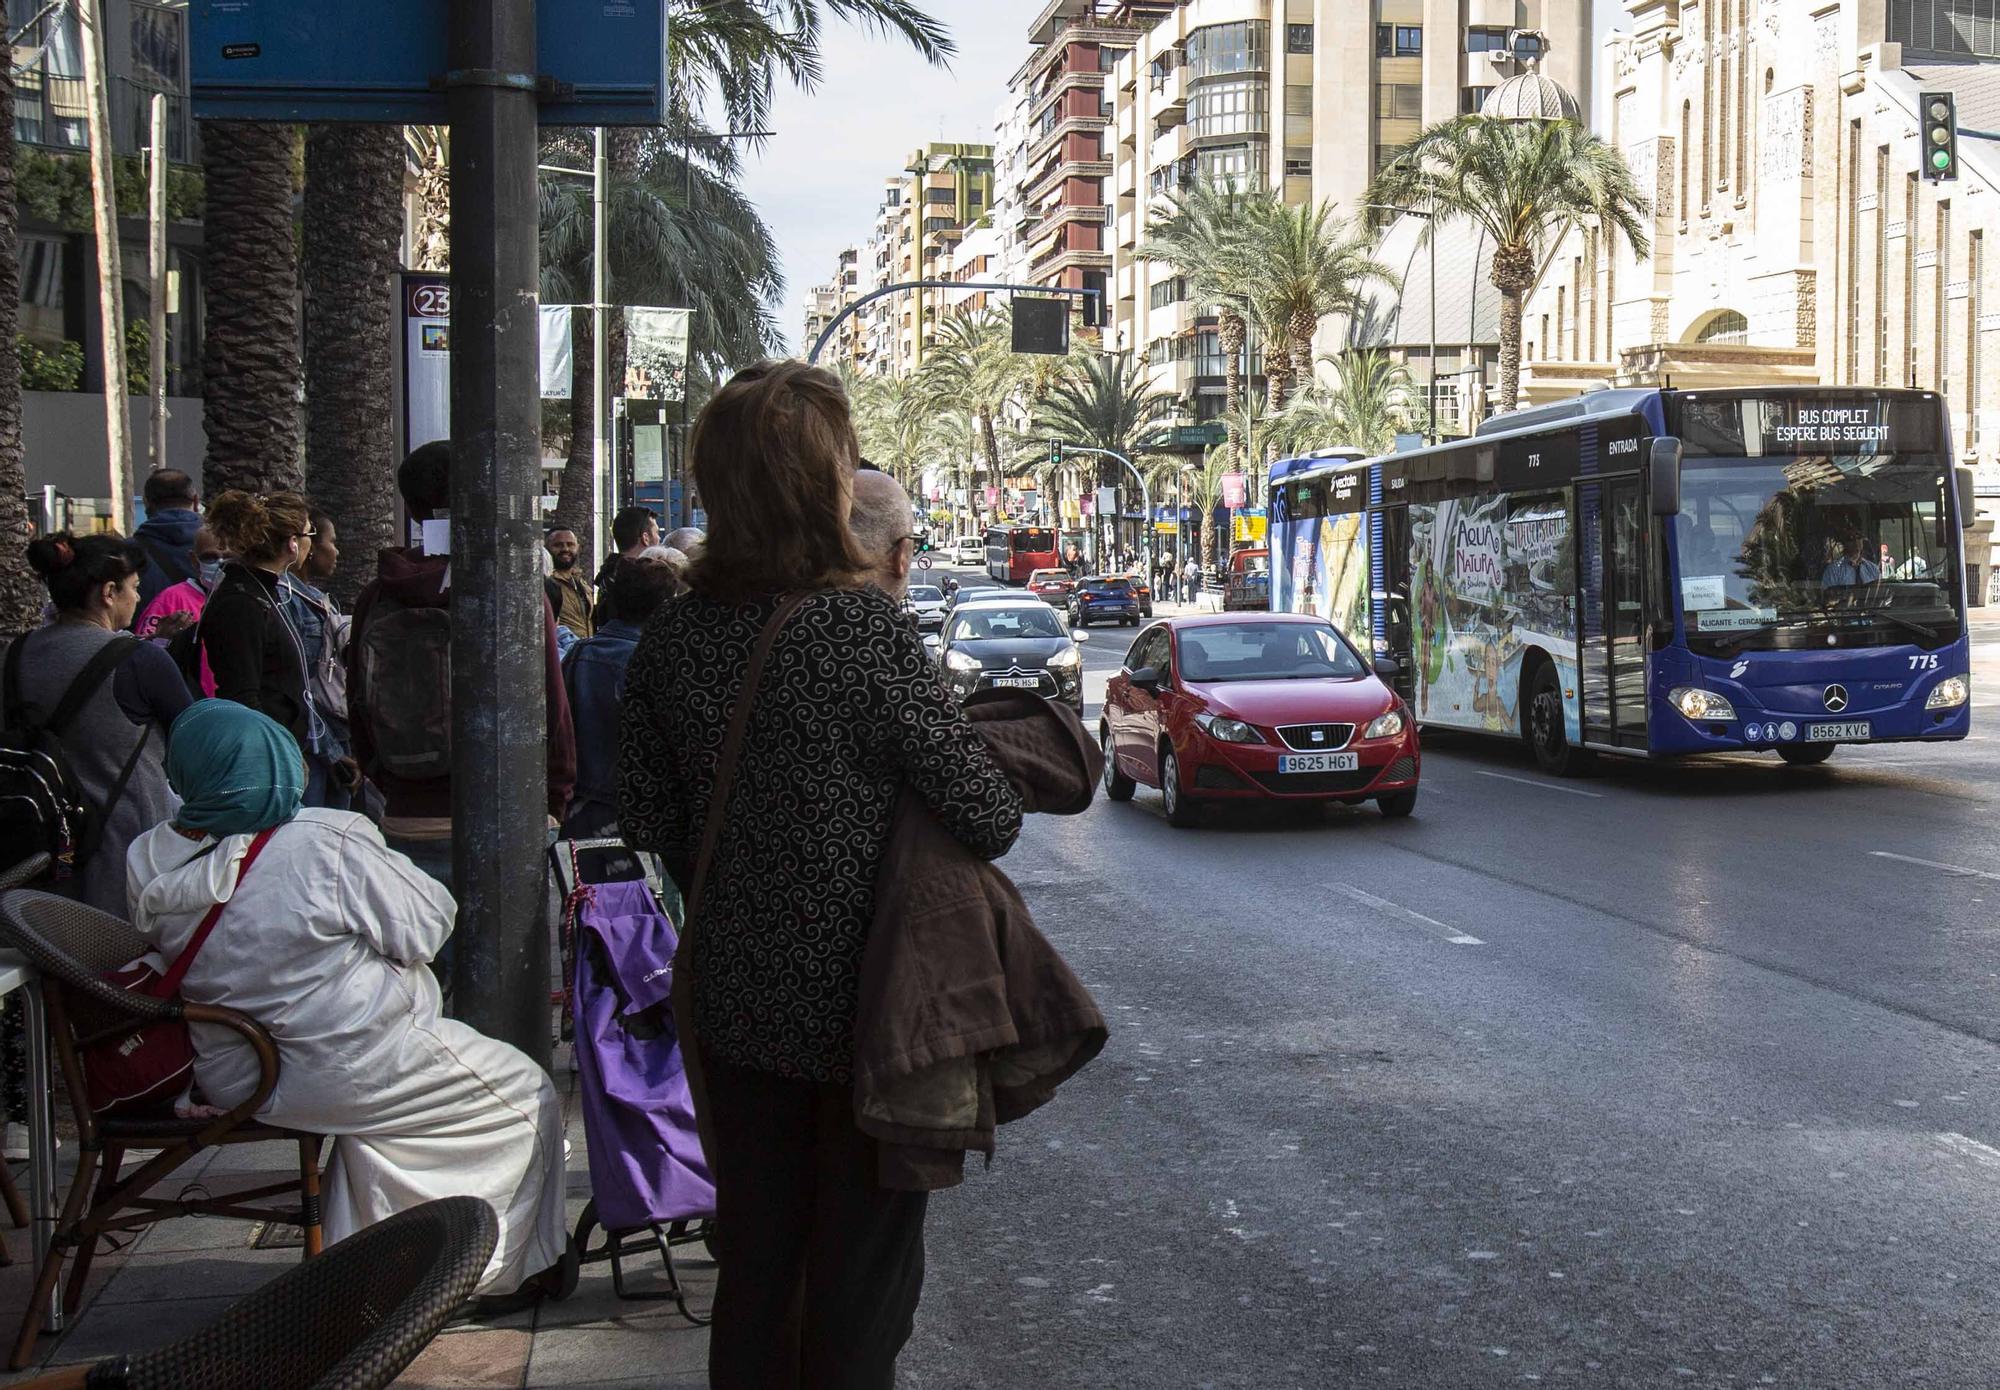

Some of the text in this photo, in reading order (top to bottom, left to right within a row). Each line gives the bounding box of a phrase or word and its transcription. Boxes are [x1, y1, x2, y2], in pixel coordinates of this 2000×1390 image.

[420, 290, 450, 312] 23
[1799, 410, 1868, 424] BUS COMPLET
[1777, 427, 1817, 441] ESPERE
[1820, 427, 1840, 440] BUS
[1609, 439, 1638, 455] ENTRADA
[1528, 454, 1540, 467] 775
[1391, 478, 1405, 490] SALIDA
[1456, 520, 1500, 554] AQUA
[1456, 549, 1501, 585] NATURA
[1701, 619, 1732, 627] ALICANTE
[1908, 655, 1938, 669] 775
[1812, 724, 1868, 738] 8562 KVC
[1289, 755, 1354, 771] 9625 HGY
